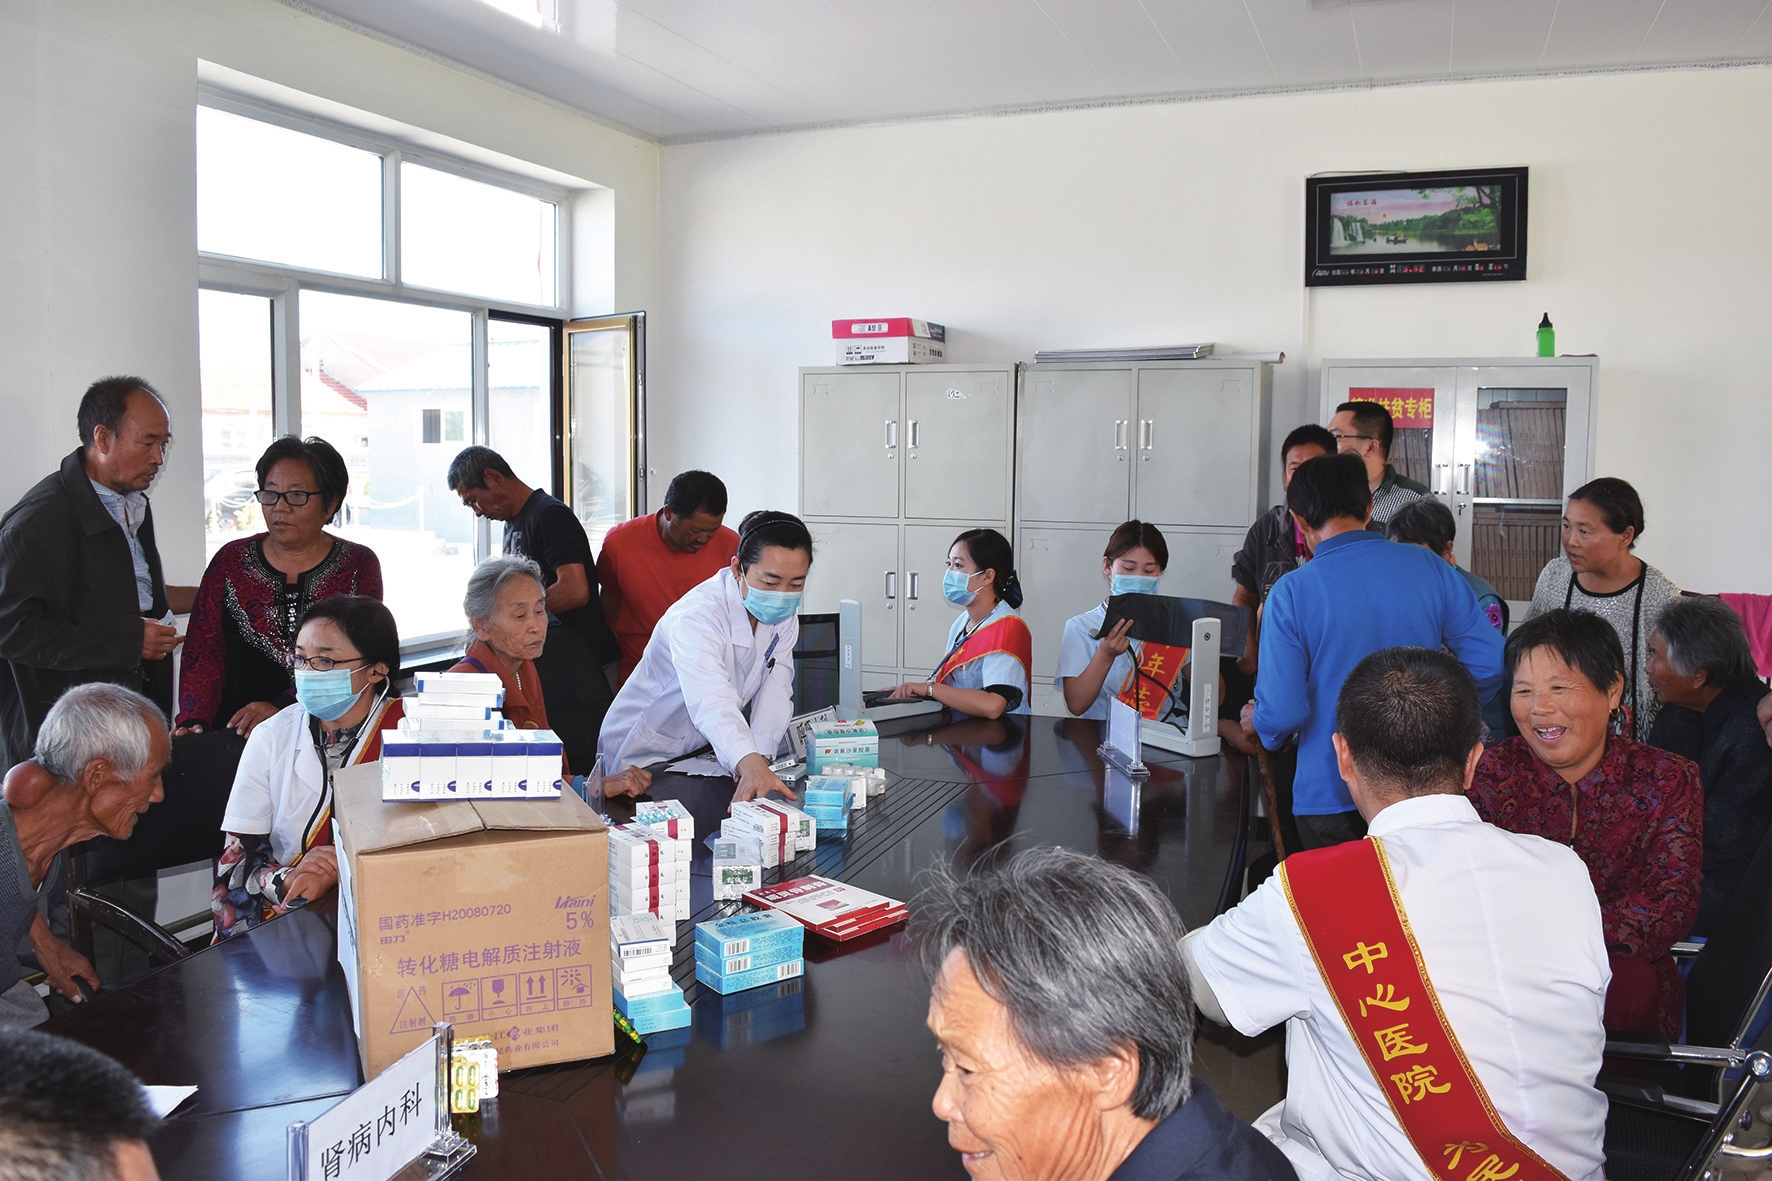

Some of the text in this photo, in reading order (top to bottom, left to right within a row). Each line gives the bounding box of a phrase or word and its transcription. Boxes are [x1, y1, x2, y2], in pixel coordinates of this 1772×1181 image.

[379, 903, 512, 931] 国药准字H20080720
[566, 910, 595, 930] 5%
[397, 939, 582, 978] 转化糖电解质注射液
[1342, 941, 1452, 1105] 中心医院
[321, 1082, 422, 1181] 肾病内科
